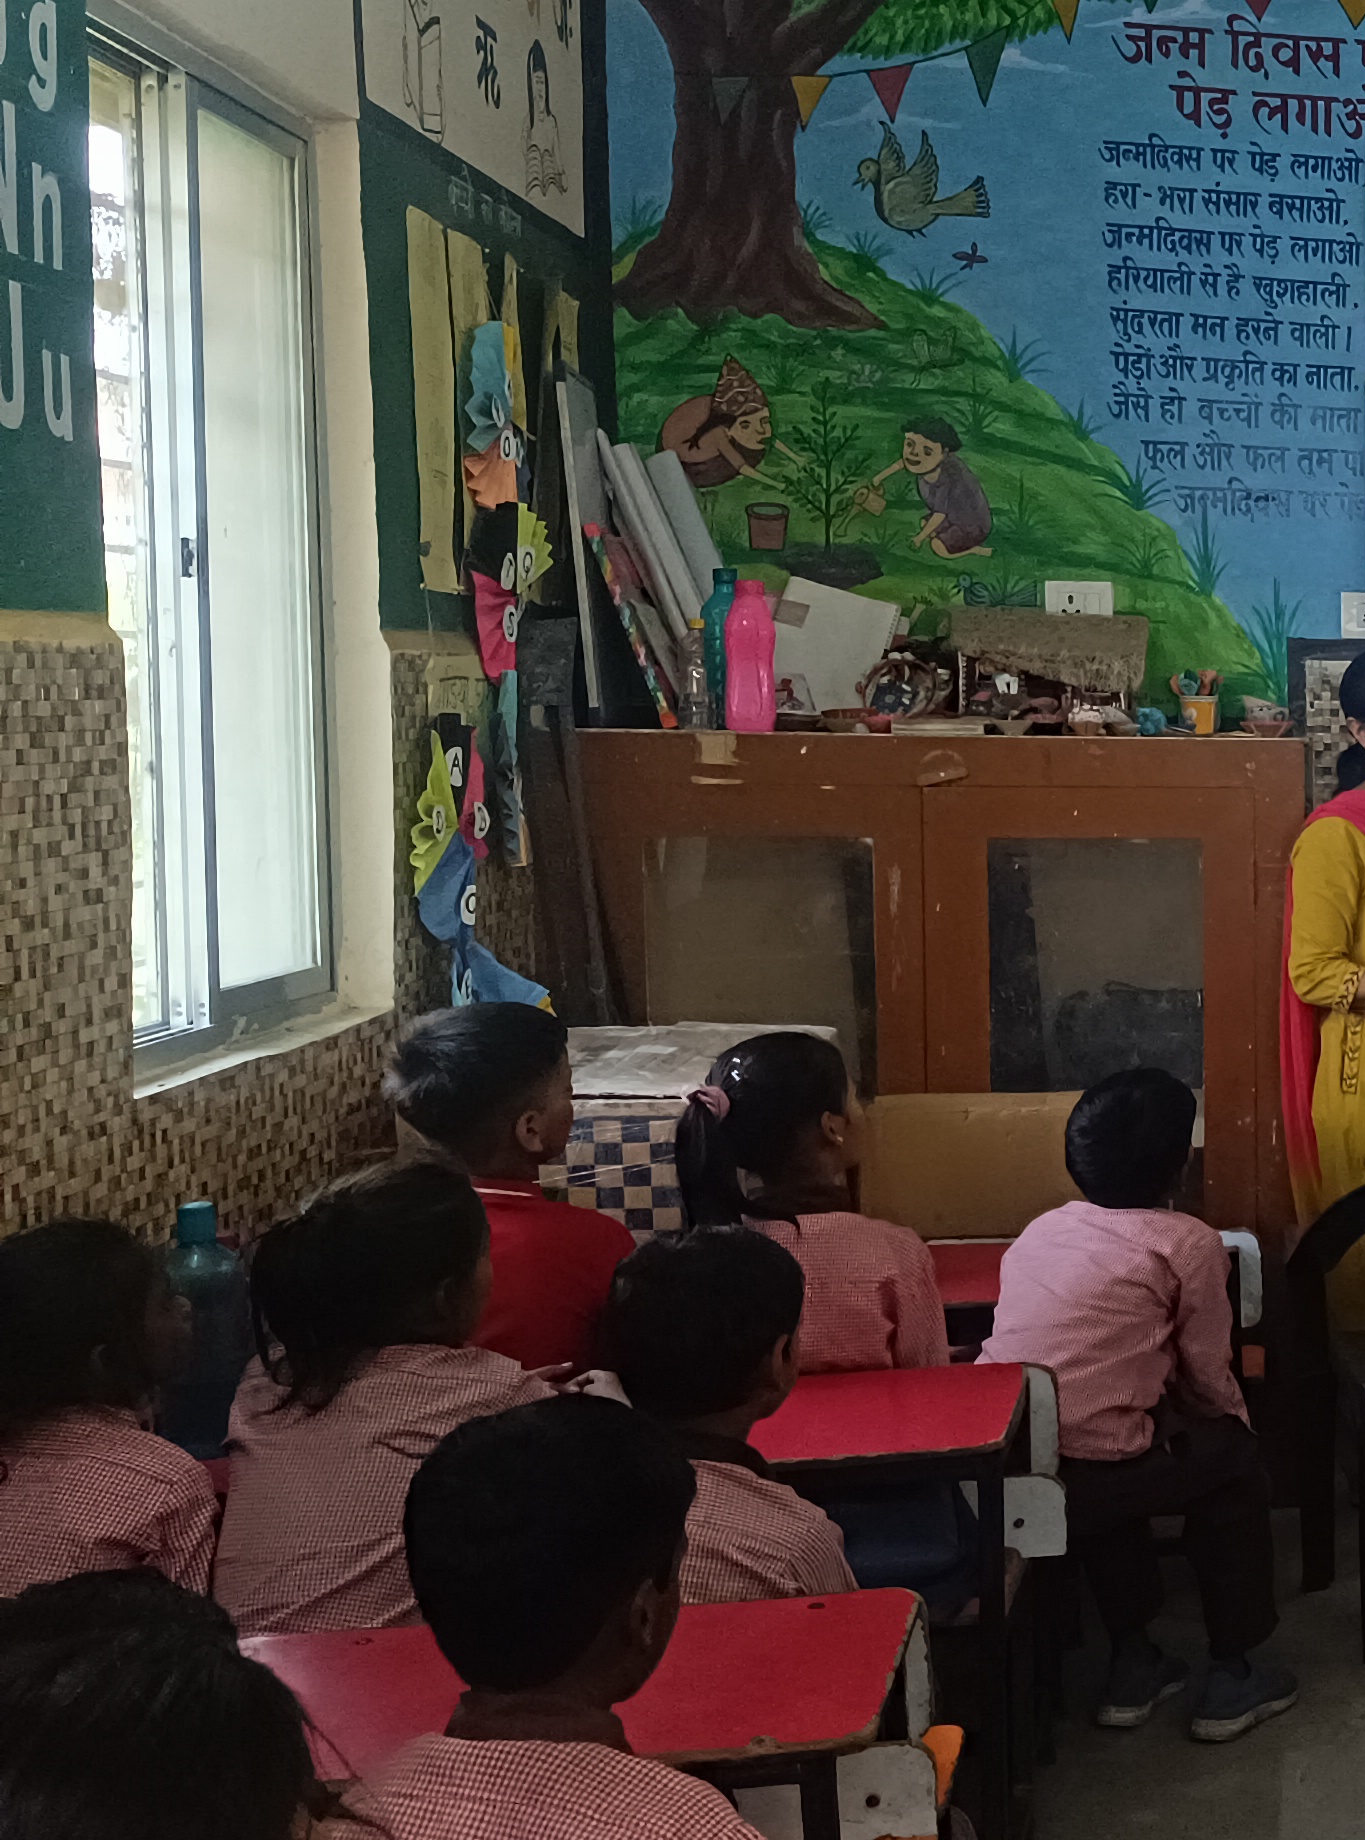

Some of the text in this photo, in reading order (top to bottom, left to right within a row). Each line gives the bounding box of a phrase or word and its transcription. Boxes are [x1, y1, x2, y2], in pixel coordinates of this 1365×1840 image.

[1111, 22, 1214, 70] जन्म
[1224, 13, 1348, 81] दिवस
[1168, 70, 1239, 140] पेड़
[1098, 133, 1282, 182] जन्मदिवस पर पेड़
[1202, 181, 1262, 218] संसार
[1102, 216, 1364, 267] जन्मदिवस पर पेड़ लगाओ
[1107, 255, 1245, 301] हरियाली से है
[1110, 300, 1283, 346] सुंदरता मन हरने
[1153, 343, 1197, 384] और
[1201, 350, 1268, 392] प्रकृति
[1271, 361, 1302, 388] का
[1160, 387, 1187, 426] हो
[1197, 392, 1263, 429] बच्चों
[1271, 392, 1302, 431] की
[1309, 405, 1363, 434] माता
[1140, 430, 1338, 481] फूल और फल तुम
[451, 752, 462, 778] A
